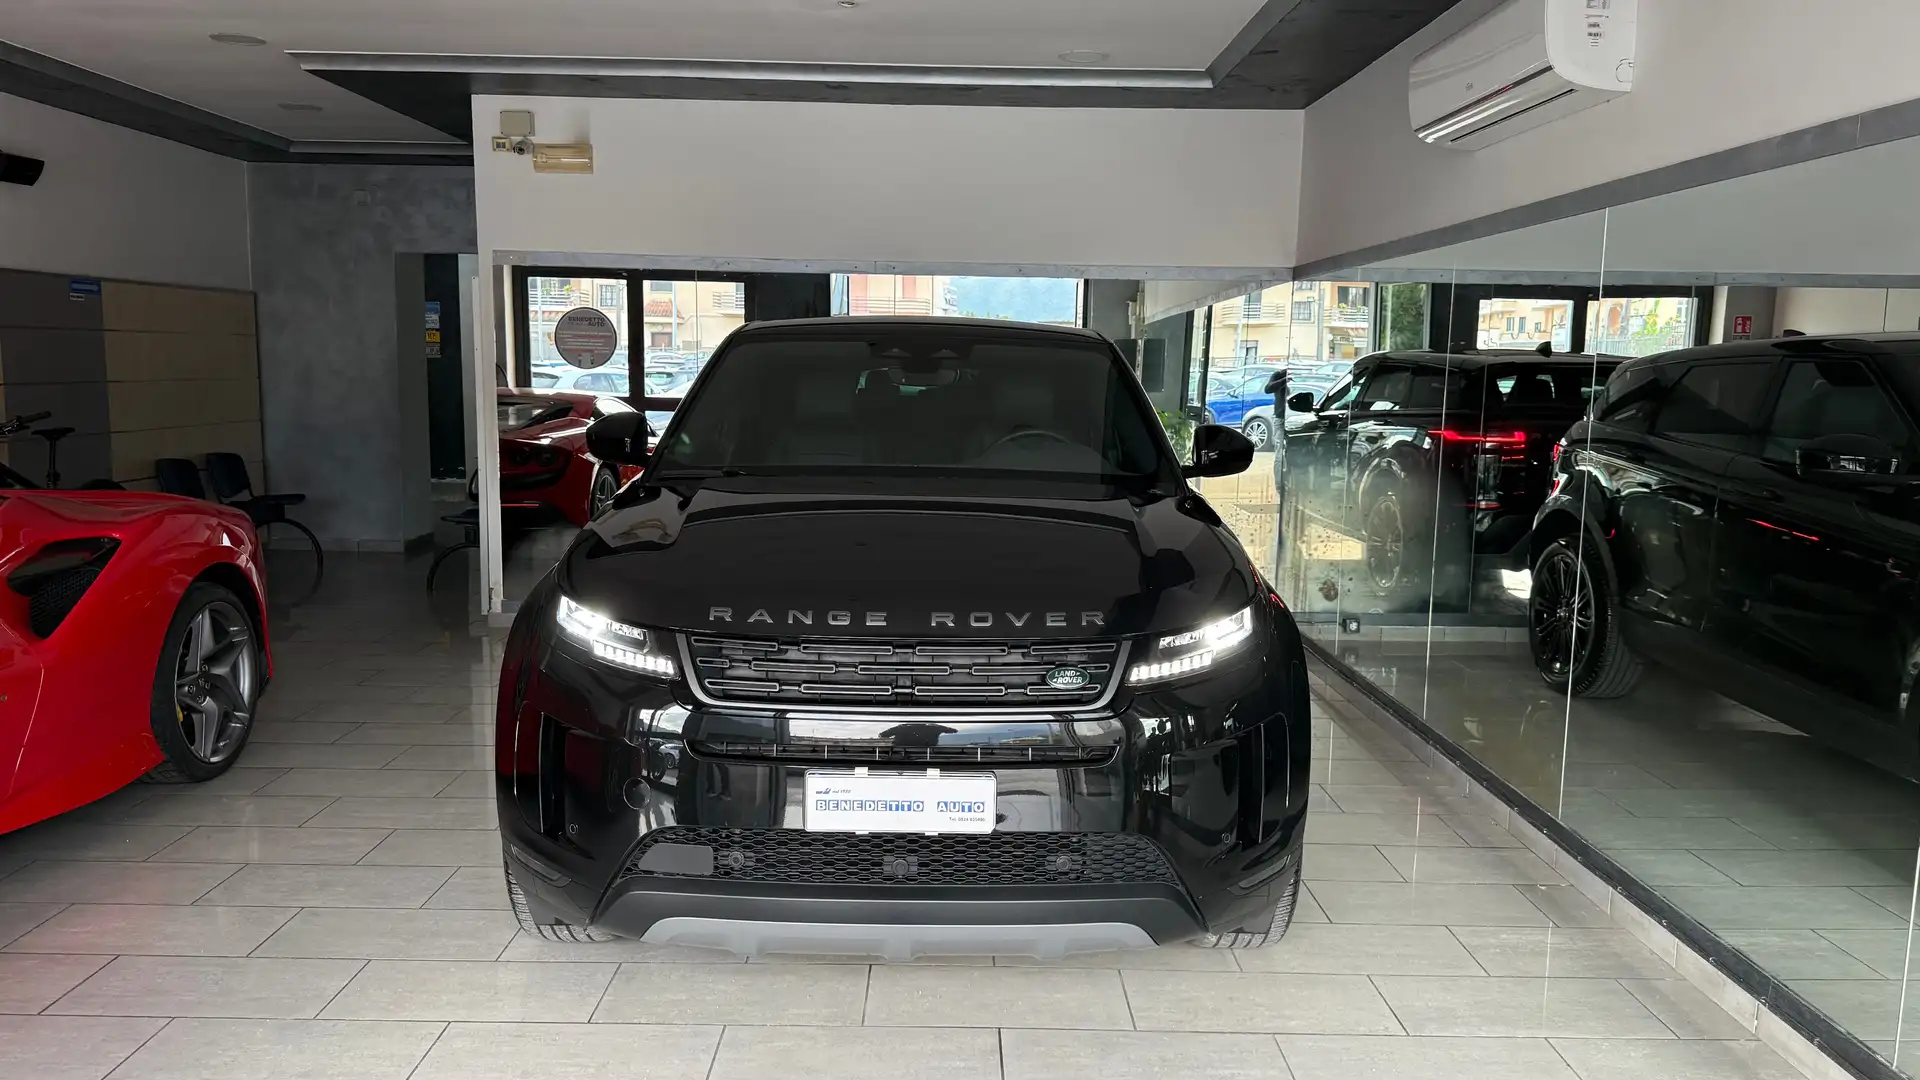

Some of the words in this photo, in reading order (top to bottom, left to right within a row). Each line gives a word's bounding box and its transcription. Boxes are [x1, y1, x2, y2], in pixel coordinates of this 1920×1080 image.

[708, 606, 888, 626] RANGE
[930, 610, 1106, 627] ROVER
[1057, 676, 1083, 684] ROVER
[815, 799, 925, 812] BENEDETTO
[936, 801, 985, 813] AUTO
